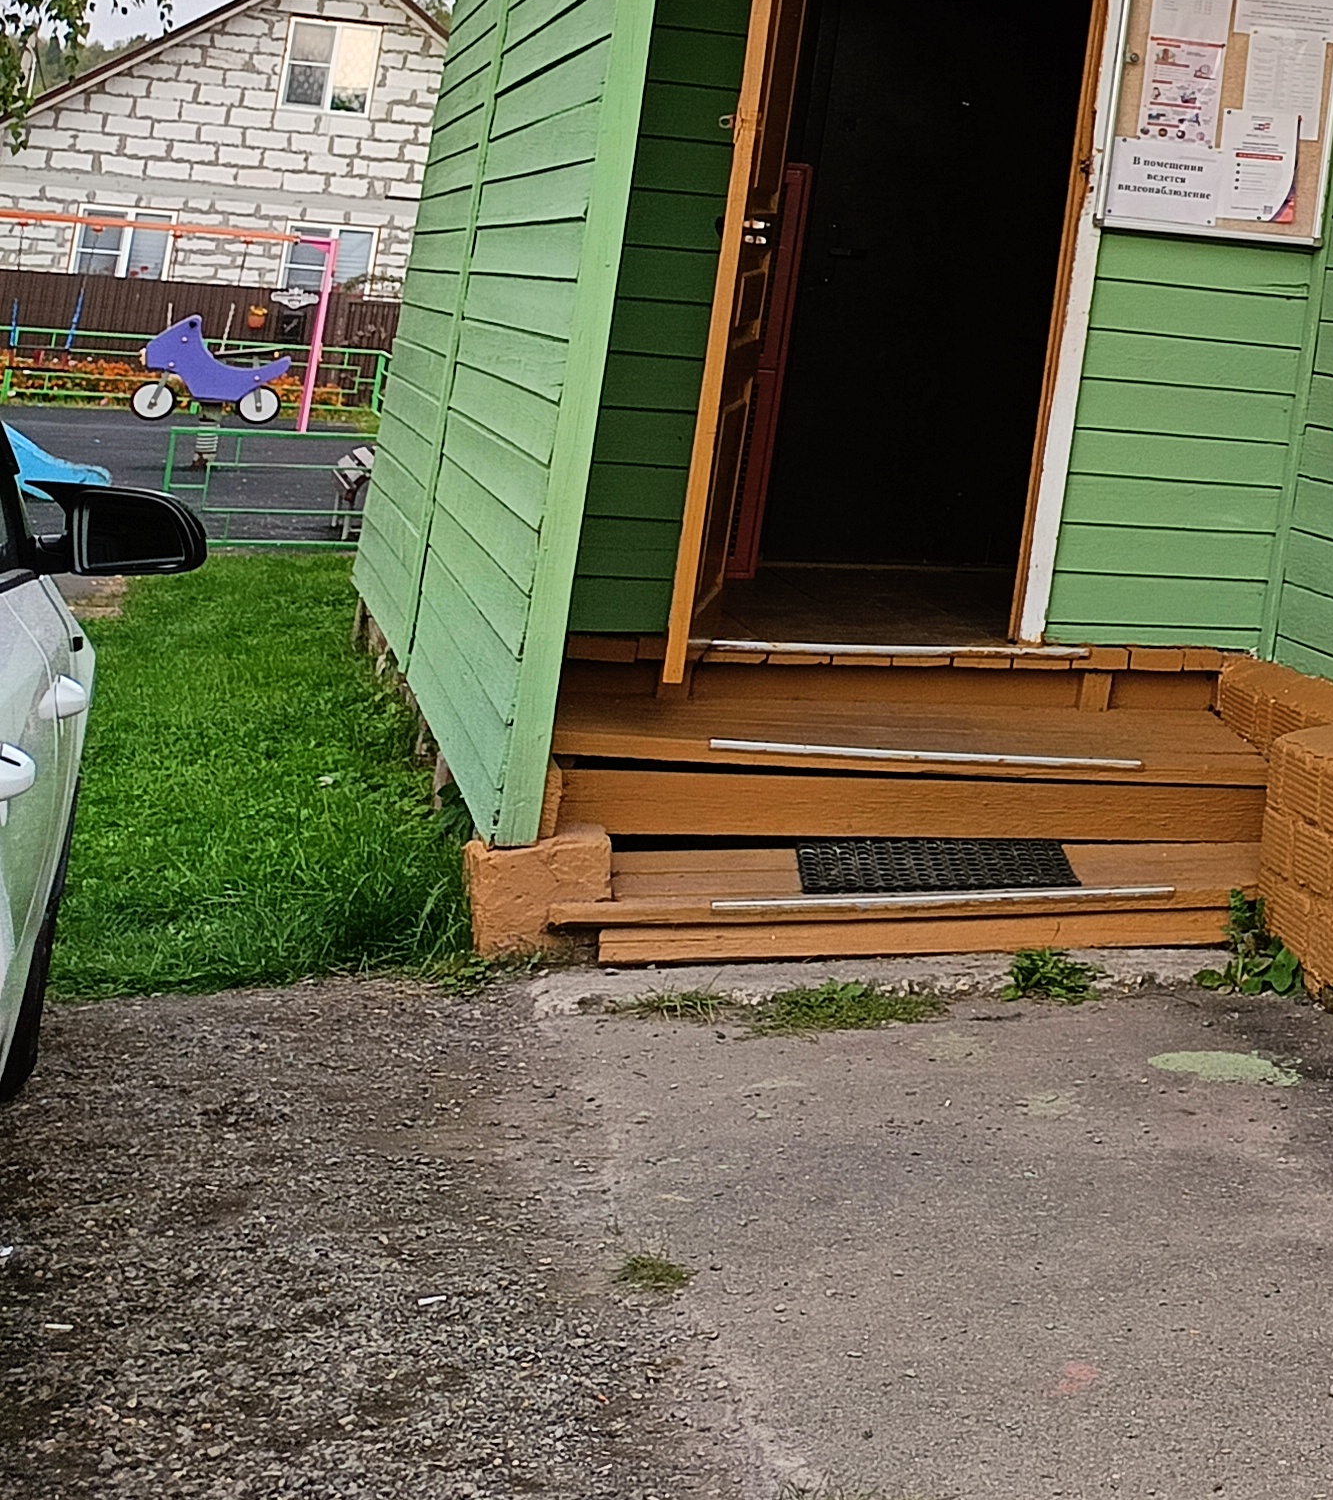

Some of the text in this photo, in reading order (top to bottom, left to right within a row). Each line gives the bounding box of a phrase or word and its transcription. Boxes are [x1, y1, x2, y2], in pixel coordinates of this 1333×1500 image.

[1132, 156, 1204, 173] В помещении
[1146, 173, 1187, 184] ведется
[1117, 183, 1211, 200] видеонаблюдение
